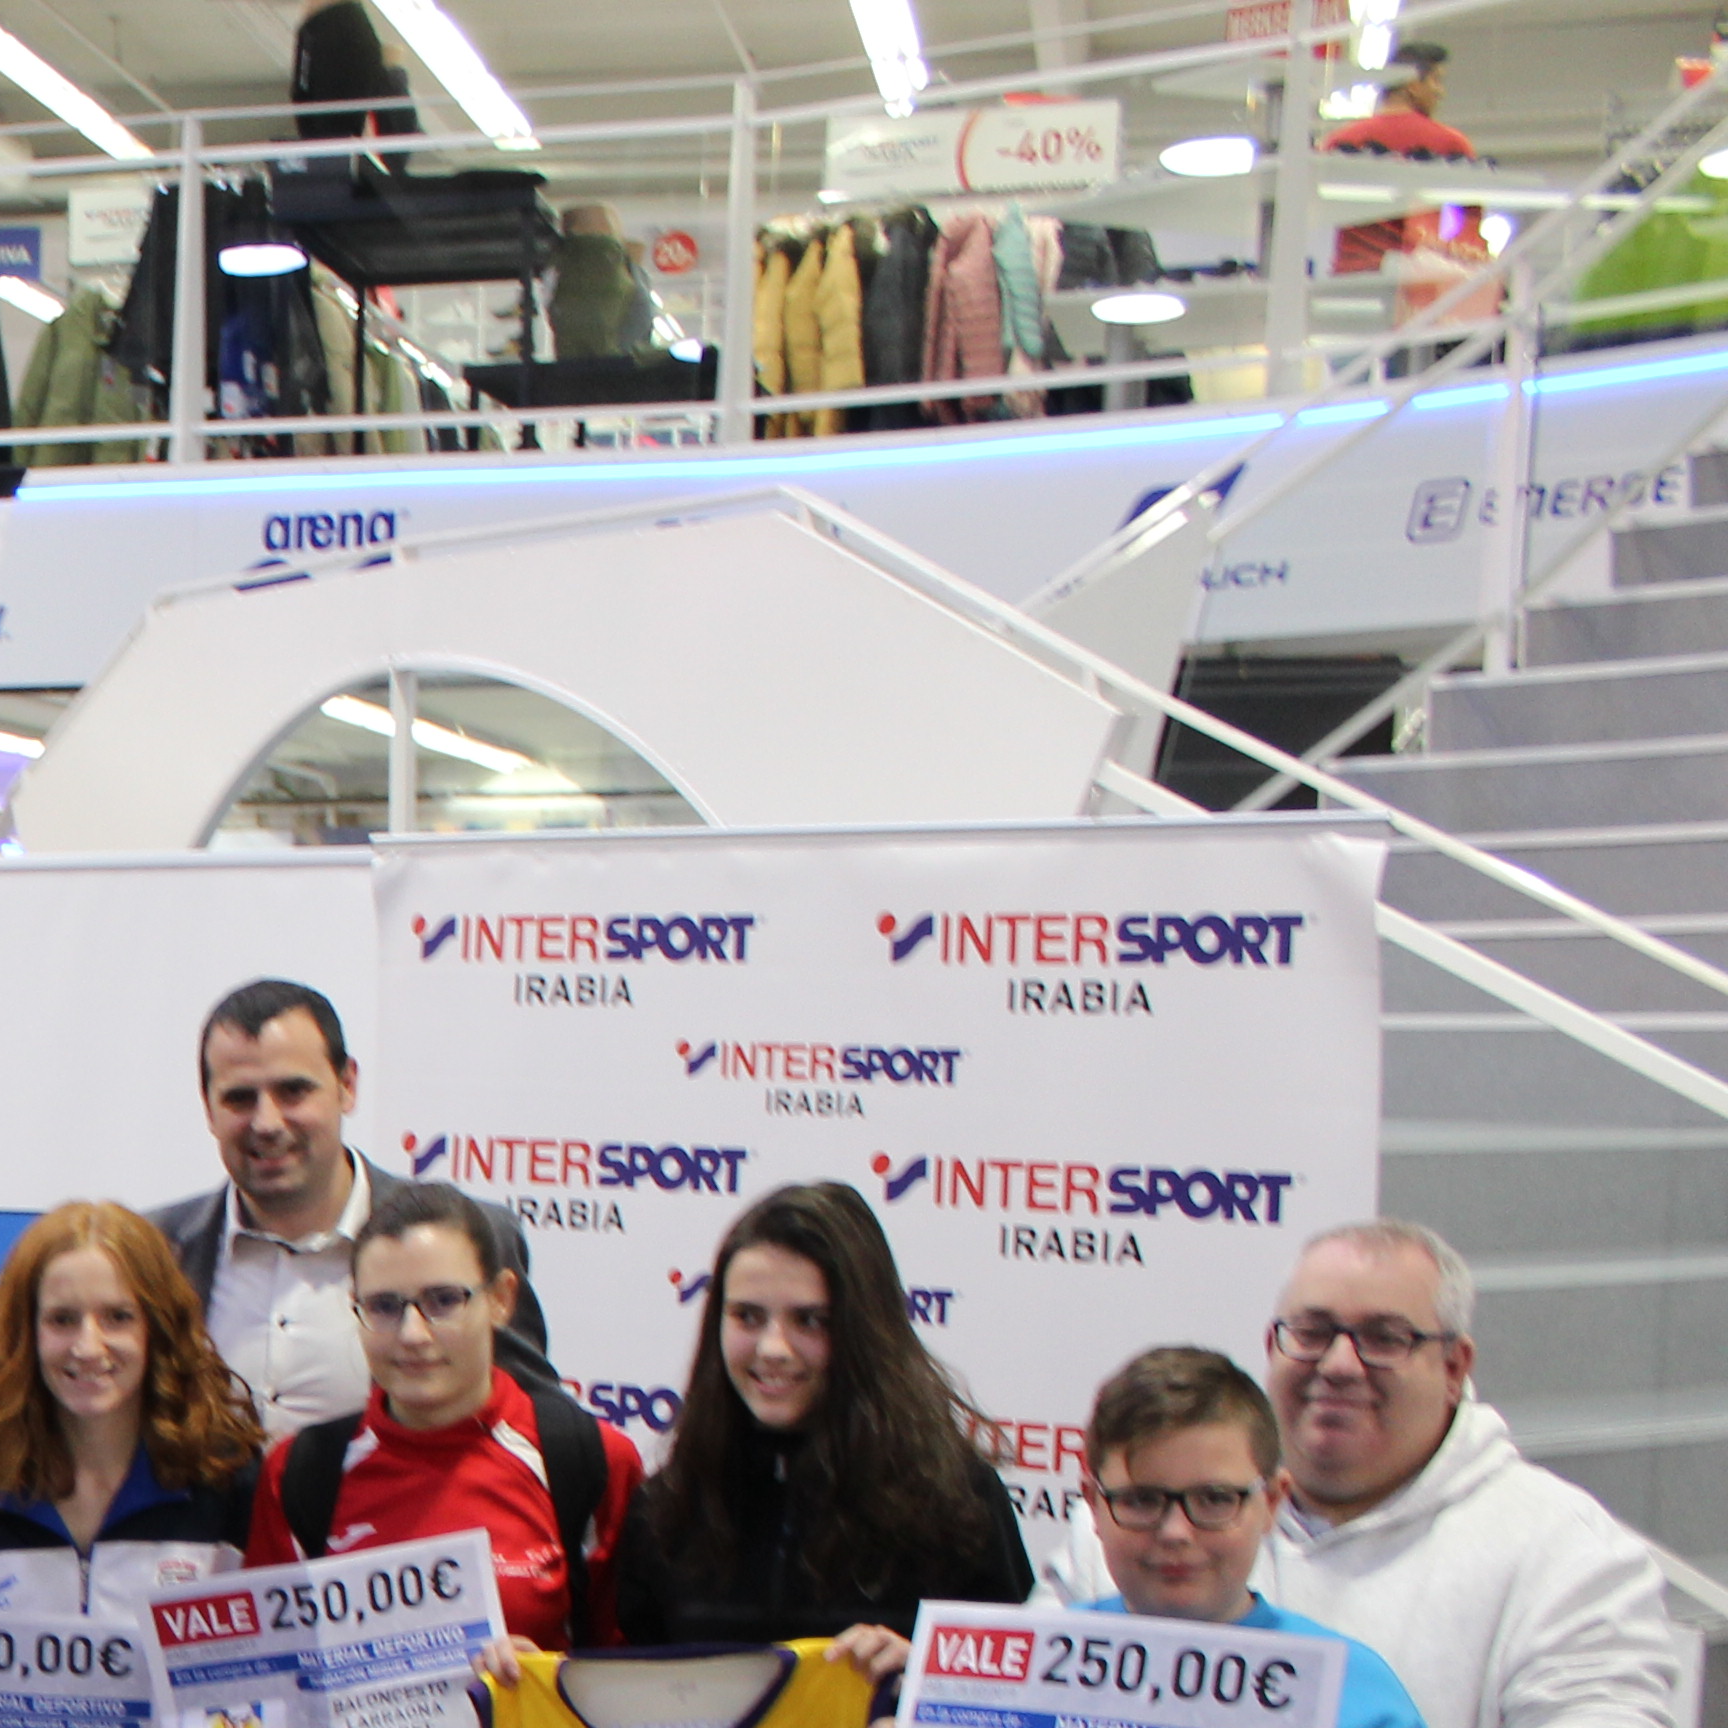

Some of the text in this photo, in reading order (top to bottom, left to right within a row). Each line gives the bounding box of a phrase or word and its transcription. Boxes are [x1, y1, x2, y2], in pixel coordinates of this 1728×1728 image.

[263, 509, 397, 551] arena
[461, 913, 755, 963] INTERSPORT
[939, 912, 1304, 965] INTERSPORT
[514, 973, 634, 1007] IRABIA
[1006, 978, 1154, 1016] IRABIA
[721, 1039, 961, 1084] INTERSPORT
[765, 1087, 866, 1118] IRABIA
[451, 1132, 747, 1195] INTERSPORT
[933, 1155, 1293, 1225] INTERSPORT
[998, 1223, 1145, 1267] IRABIA
[161, 1598, 252, 1641] VALE
[264, 1558, 462, 1631] 250,00€
[374, 1625, 465, 1659] DEPORTIVO
[935, 1631, 1298, 1711] VALE 250,00€
[33, 1696, 126, 1717] DEPORTIVO
[333, 1680, 449, 1714] BALONCESTO
